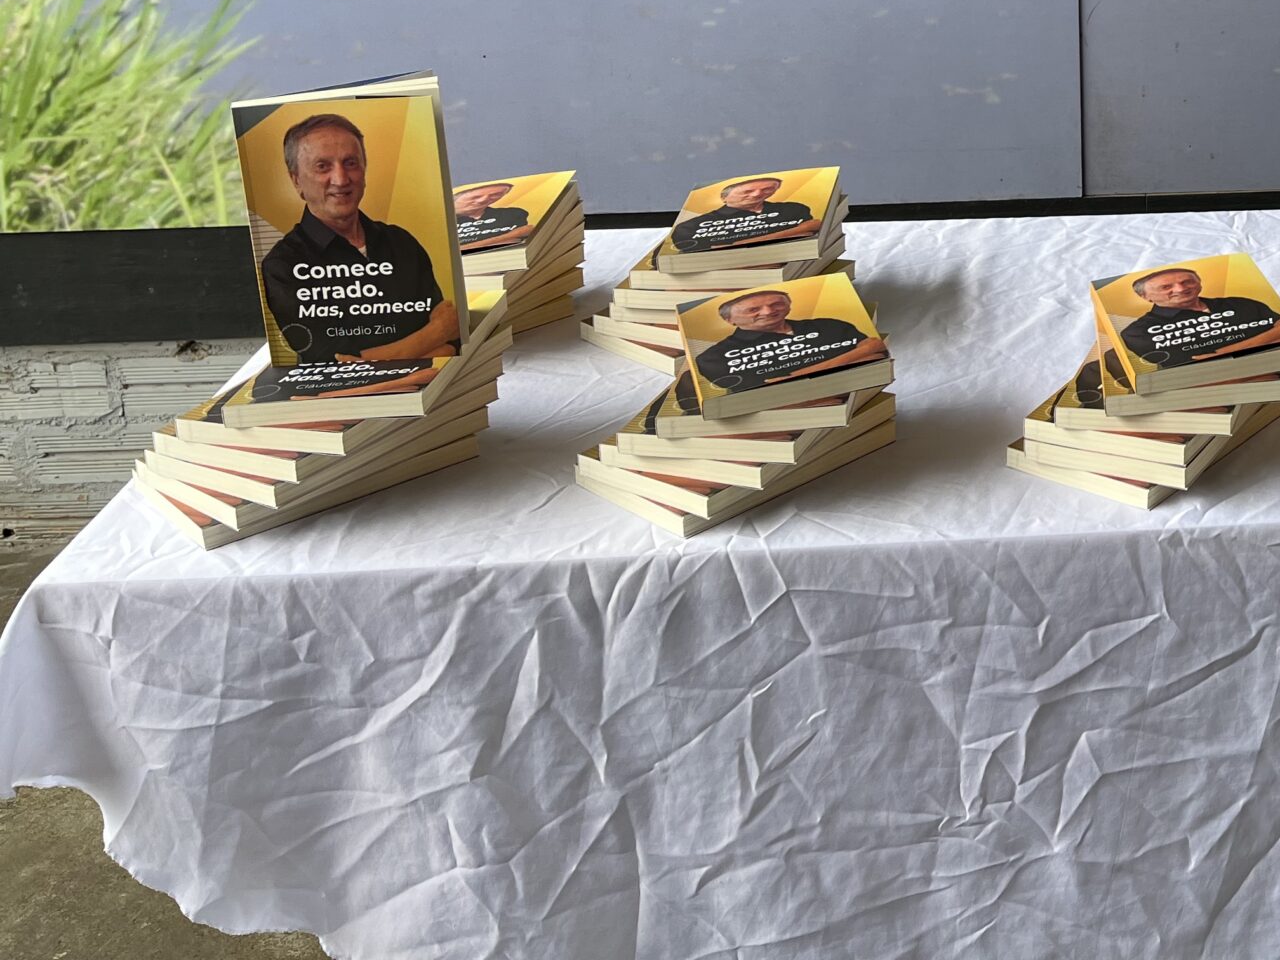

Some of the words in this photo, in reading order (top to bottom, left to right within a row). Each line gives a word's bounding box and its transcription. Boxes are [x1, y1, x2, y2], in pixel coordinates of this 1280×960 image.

[696, 220, 765, 233] errado.
[699, 212, 779, 227] Comece
[734, 219, 803, 232] comece!
[293, 262, 393, 280] Comece
[296, 281, 383, 301] errado.
[299, 305, 343, 318] Mas,
[350, 298, 431, 315] comece!
[326, 326, 372, 337] Cláudio
[375, 324, 396, 335] Zini
[1148, 311, 1235, 334] Comece
[1152, 321, 1229, 342] errado.
[1155, 338, 1195, 349] Mas,
[1200, 318, 1273, 338] comece!
[1182, 338, 1223, 351] Cláudio
[1225, 333, 1245, 342] Zini
[725, 332, 819, 358] Comece
[728, 344, 811, 366] errado.
[729, 361, 772, 373] Mas,
[778, 338, 857, 361] comece!
[756, 361, 800, 374] Cláudio
[804, 355, 824, 363] Zini
[278, 373, 324, 383] Mas,
[331, 367, 419, 379] comece!
[288, 363, 375, 376] errado.
